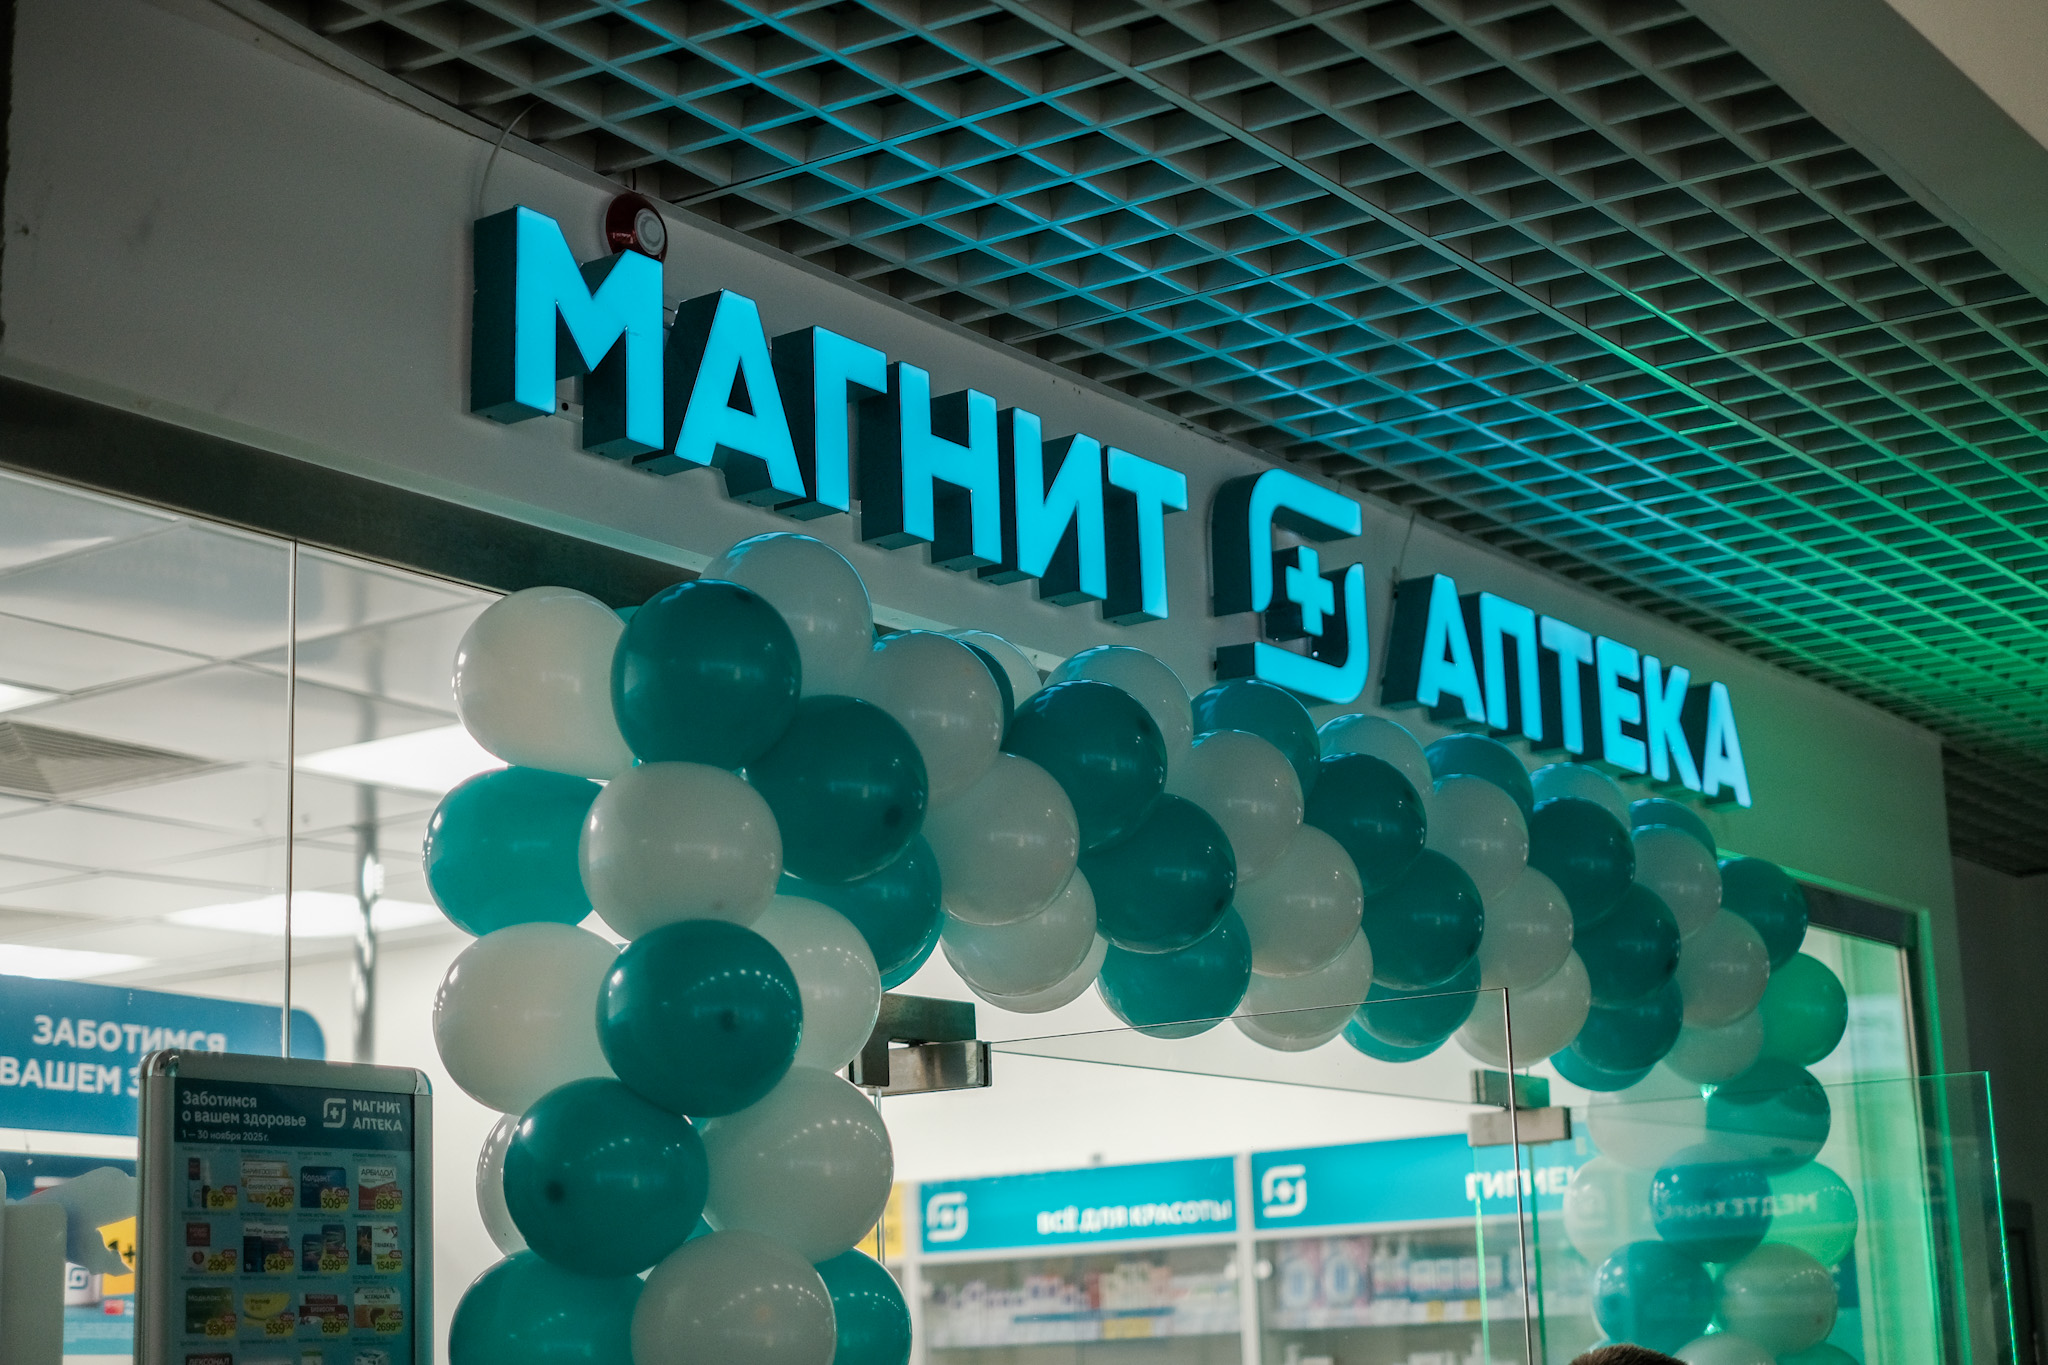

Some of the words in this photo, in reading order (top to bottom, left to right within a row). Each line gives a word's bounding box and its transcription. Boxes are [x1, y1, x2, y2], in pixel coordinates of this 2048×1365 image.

[514, 204, 1188, 620] МАГНИТ
[1416, 573, 1751, 807] АПТЕКА
[32, 1014, 227, 1054] ЗАБОТИМСЯ
[0, 1055, 120, 1095] ВАШЕМ
[182, 1091, 257, 1108] Заботимся
[352, 1099, 401, 1113] МАГНИТ
[182, 1111, 190, 1121] о
[194, 1110, 240, 1124] вашем
[243, 1111, 307, 1128] здоровье
[352, 1117, 403, 1131] АПТЕКА
[197, 1131, 209, 1139] 30
[210, 1131, 241, 1142] ноября
[361, 1168, 394, 1177] АРБИДОЛ
[1037, 1205, 1079, 1235] ВСЁ
[1079, 1205, 1129, 1233] ДЛЯ
[1129, 1199, 1233, 1227] КРАСОТЫ
